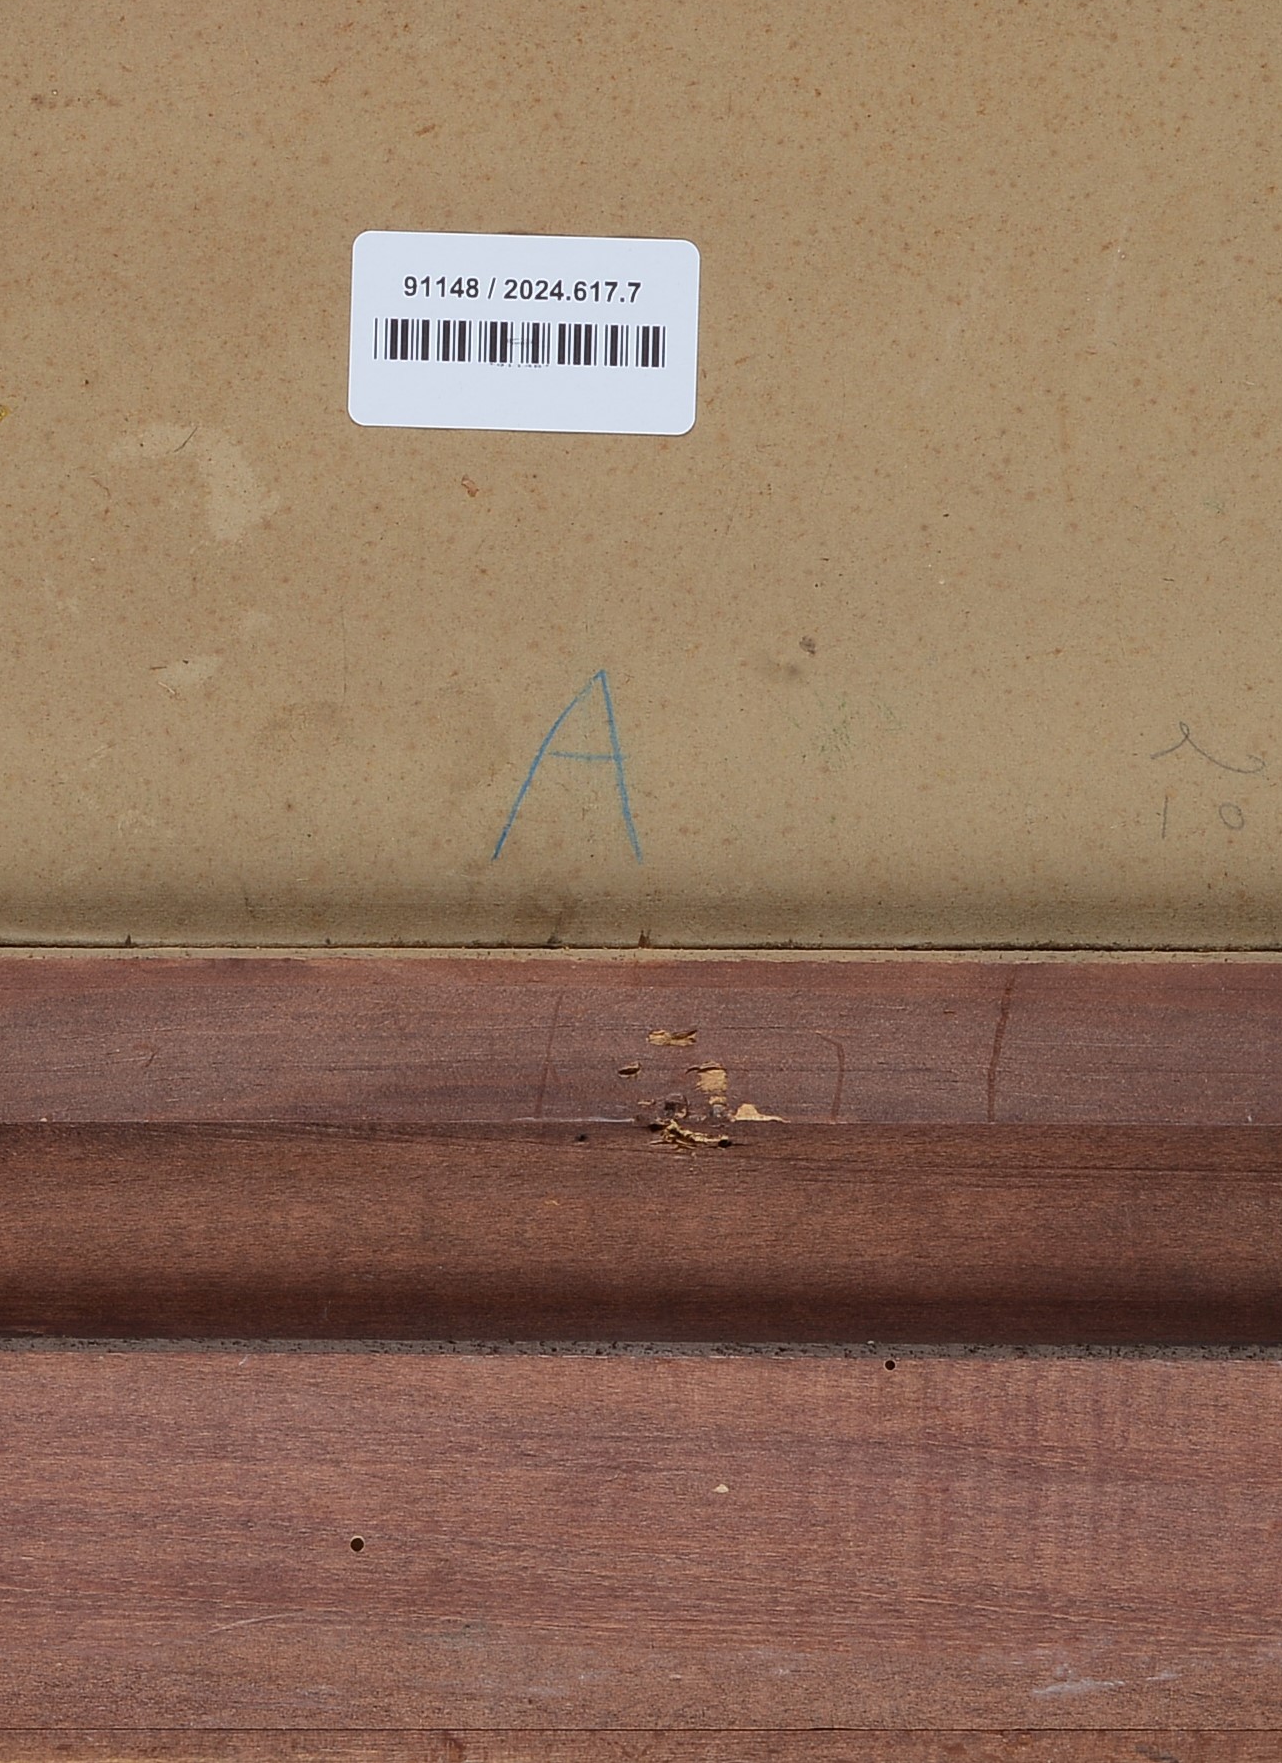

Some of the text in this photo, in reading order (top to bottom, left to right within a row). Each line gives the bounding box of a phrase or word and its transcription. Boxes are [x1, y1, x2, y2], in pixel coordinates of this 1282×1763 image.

[403, 275, 642, 303] 91148 / 2024.617.7
[489, 668, 644, 865] A
